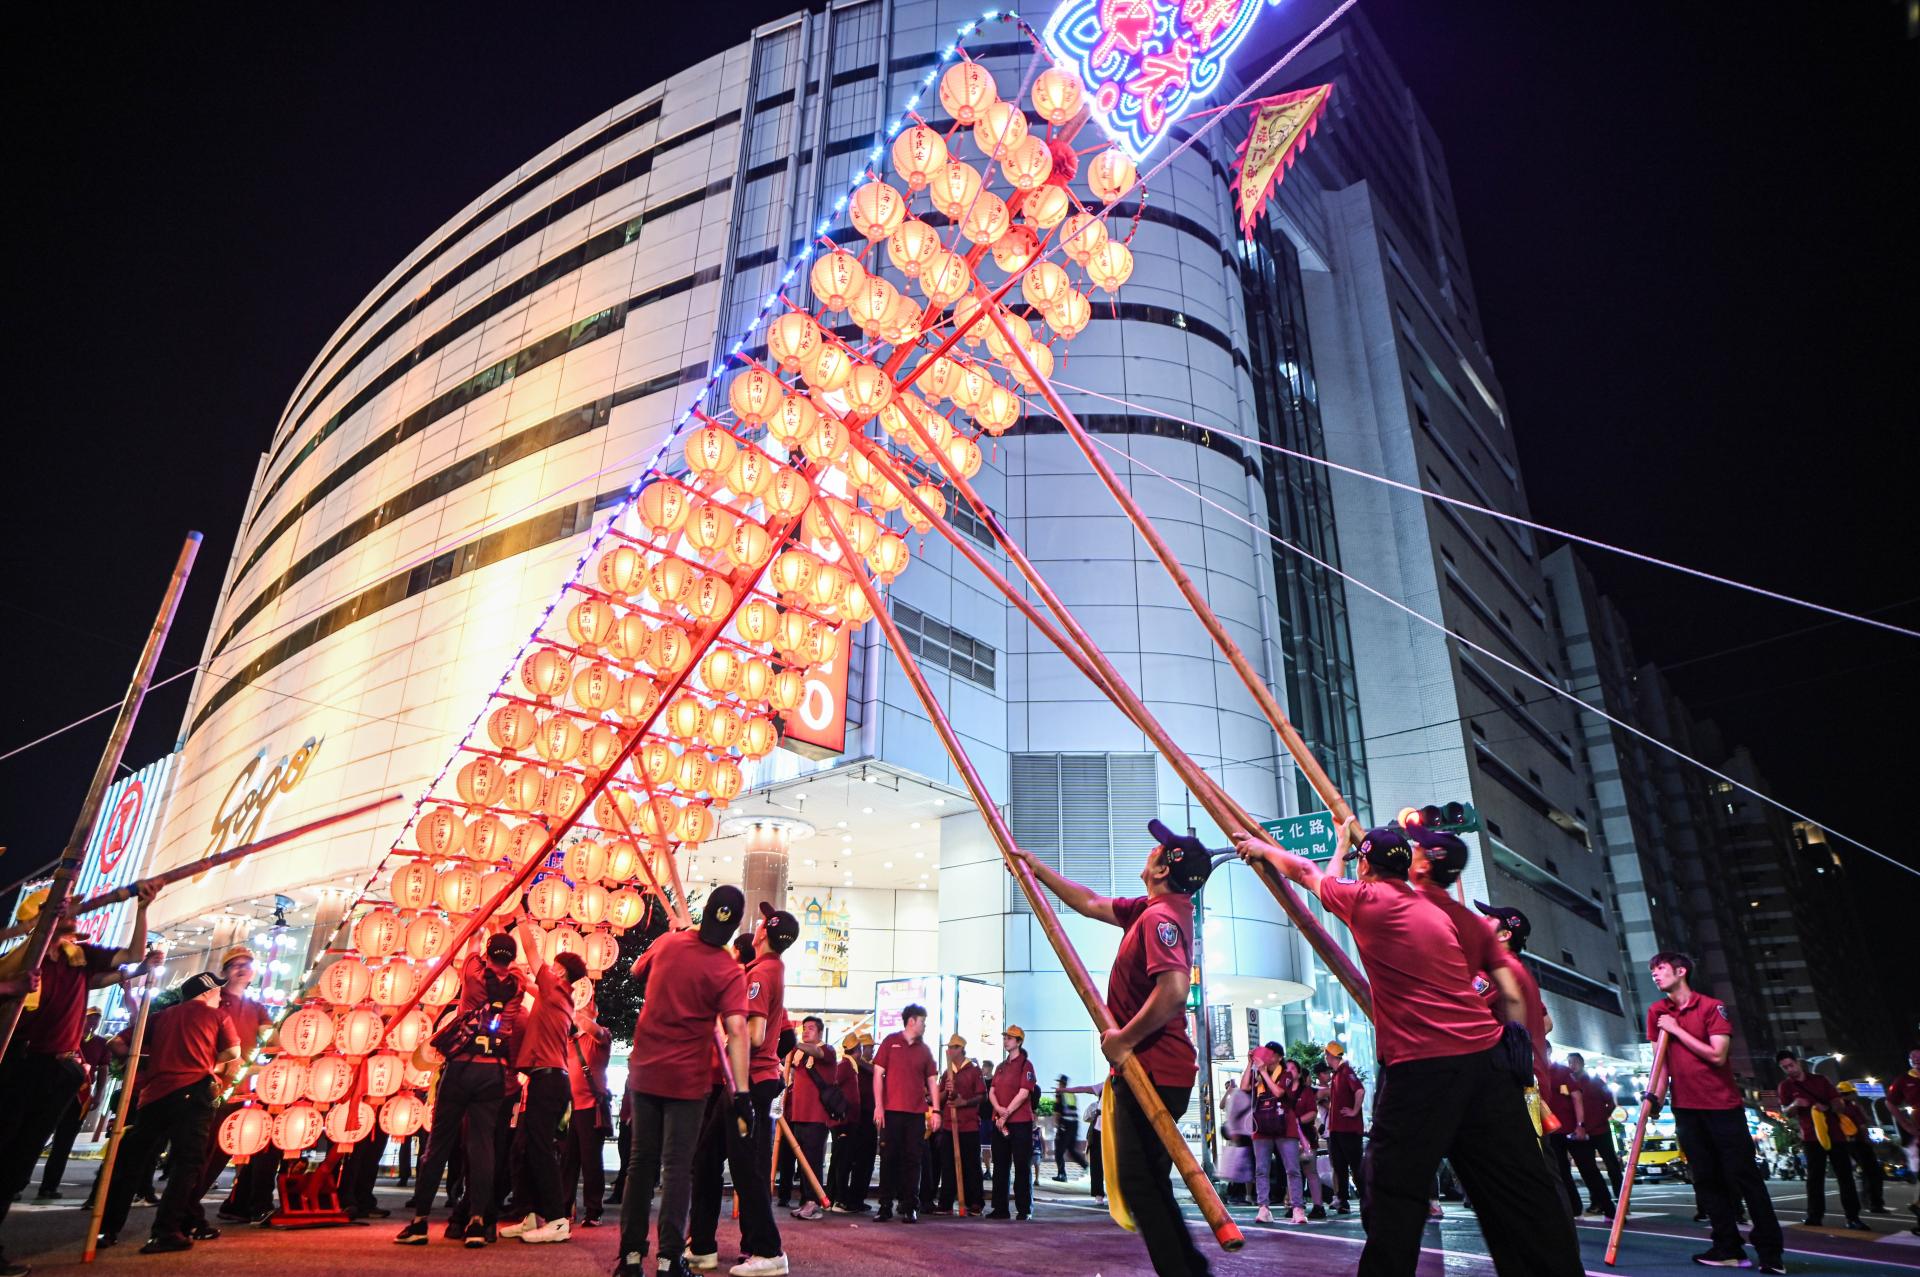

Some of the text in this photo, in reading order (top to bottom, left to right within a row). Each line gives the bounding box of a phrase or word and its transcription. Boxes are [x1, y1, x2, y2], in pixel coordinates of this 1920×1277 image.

[703, 578, 713, 608] 國泰民安
[476, 763, 487, 796] 風調雨順
[437, 819, 445, 849] 仁海宮
[478, 824, 488, 854] 仁海宮
[1269, 818, 1325, 841] 元化路
[1312, 842, 1329, 854] Rd.
[412, 869, 422, 902] 風調雨順
[463, 876, 472, 906] 仁海宮
[382, 922, 393, 951] 仁海宮
[426, 926, 438, 955] 仁海宮
[301, 1019, 311, 1050] 仁海宮
[271, 1071, 279, 1099] 仁海宮
[226, 1114, 239, 1149] 國泰民安
